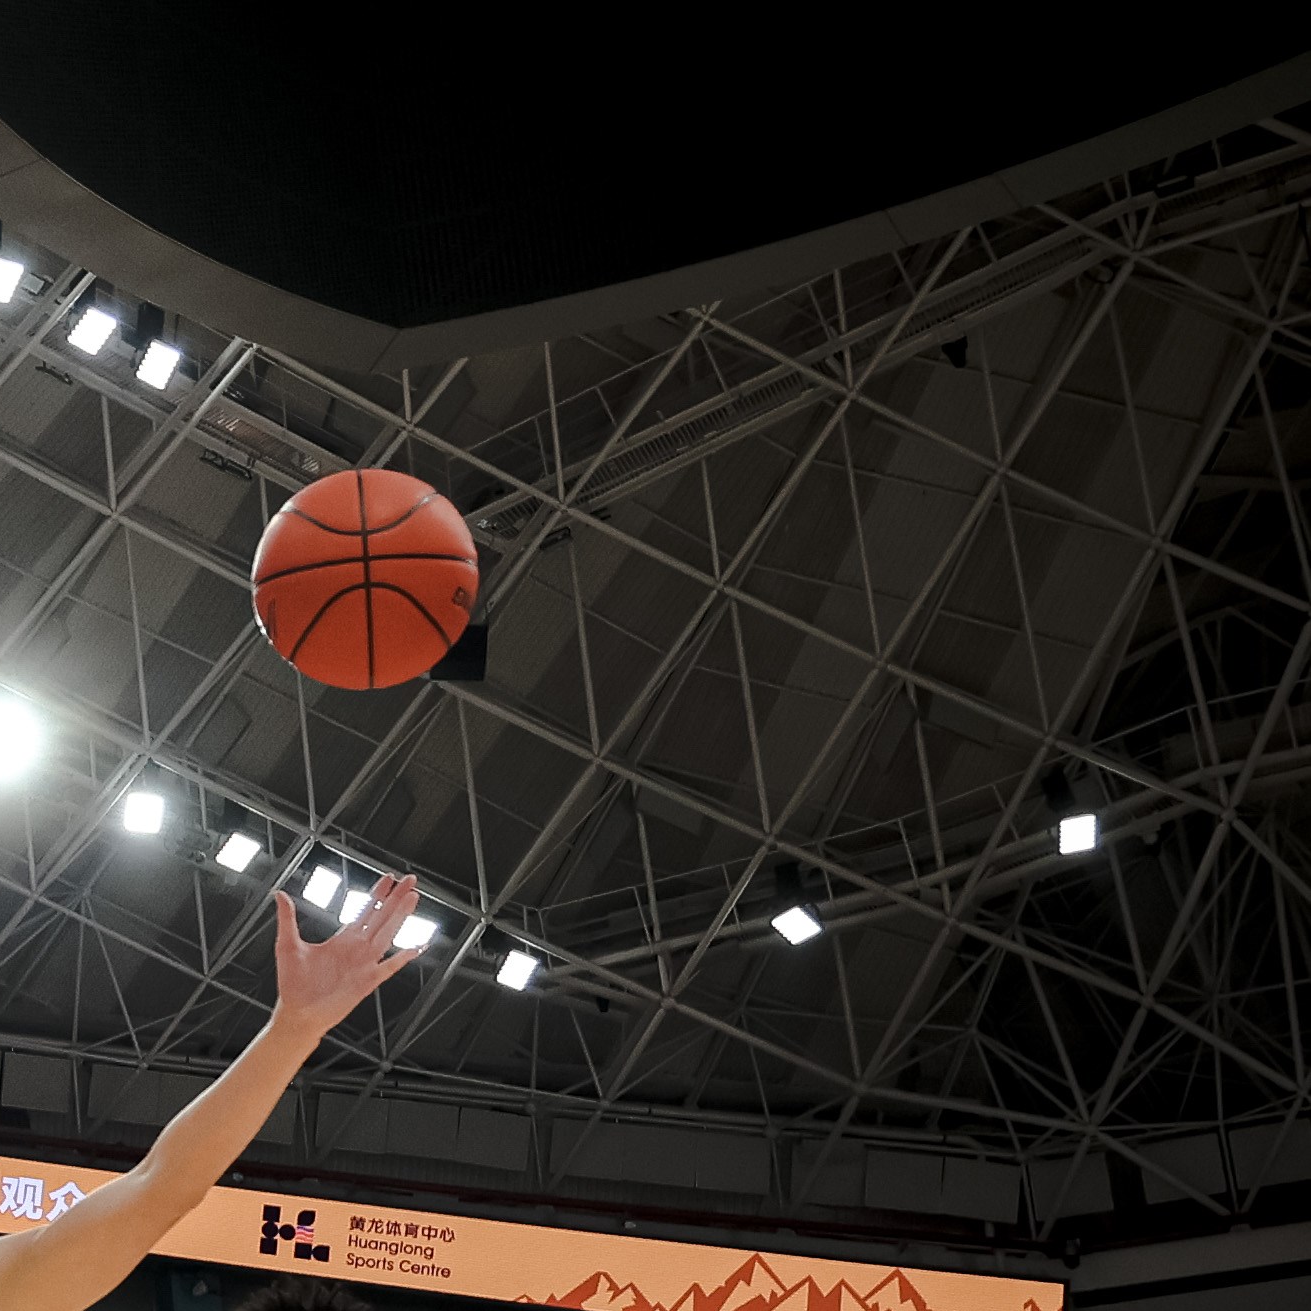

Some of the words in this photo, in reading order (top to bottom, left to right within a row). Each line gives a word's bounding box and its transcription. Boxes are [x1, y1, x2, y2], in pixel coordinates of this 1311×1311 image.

[348, 1215, 456, 1244] 黄龙体育中心
[347, 1234, 435, 1260] Huanglong
[345, 1252, 395, 1271] Sports
[399, 1260, 452, 1279] Centre
